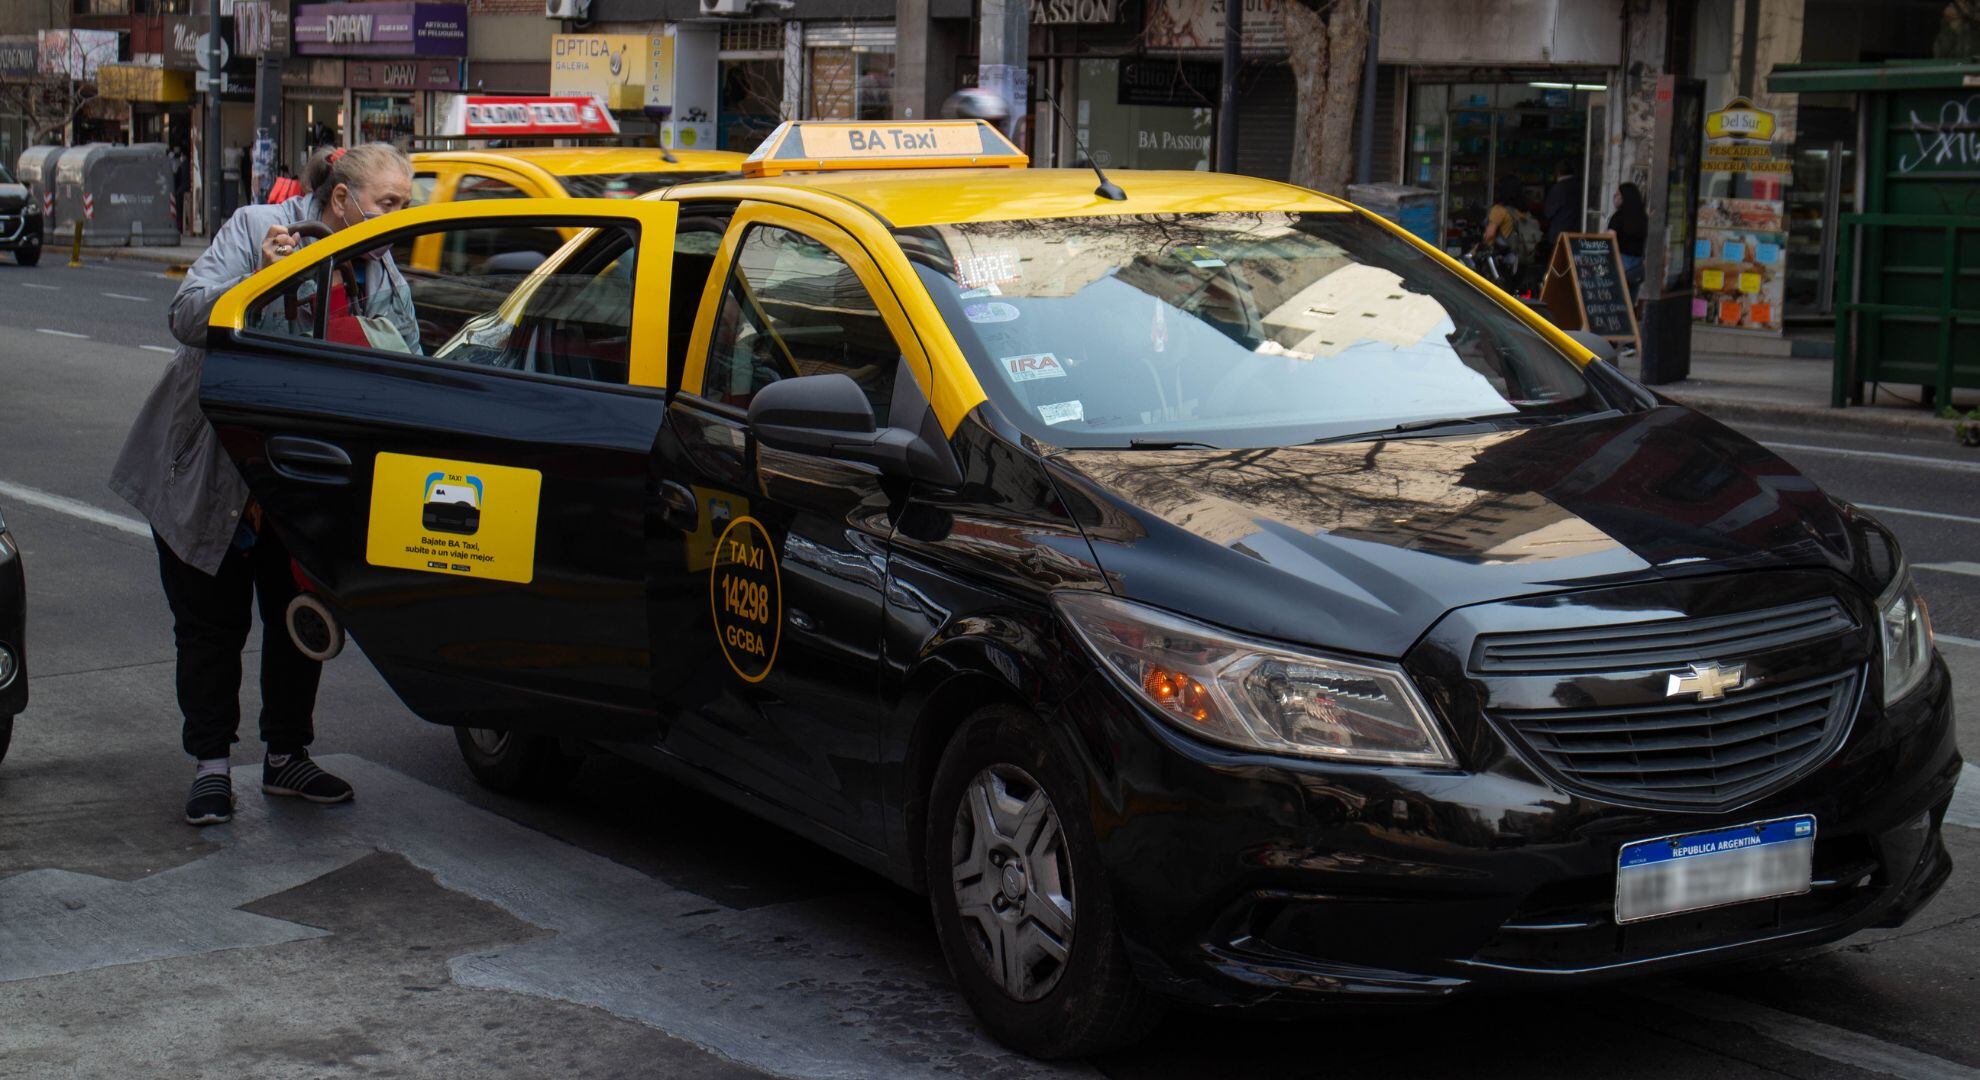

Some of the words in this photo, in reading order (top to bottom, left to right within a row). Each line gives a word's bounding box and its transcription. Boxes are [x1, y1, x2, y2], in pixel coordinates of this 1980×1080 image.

[556, 39, 610, 57] OPTICA
[555, 61, 590, 71] GALERIA
[652, 38, 662, 103] OPTICA
[467, 103, 529, 127] RADIO
[530, 103, 581, 125] TAXI
[1720, 114, 1739, 128] Del
[1741, 114, 1762, 129] Sur
[848, 129, 886, 150] BA
[887, 128, 937, 149] Taxi
[1138, 130, 1158, 148] BA
[1162, 131, 1211, 150] PASSION
[957, 254, 1014, 285] LIBRE
[1011, 356, 1058, 373] IRA
[448, 474, 462, 482] TAXI
[405, 545, 430, 555] subite
[438, 549, 448, 557] un
[450, 550, 469, 560] viaje
[470, 553, 495, 562] mejor.
[421, 536, 446, 547] Bajate
[448, 539, 460, 548] BA
[463, 541, 480, 551] Taxi,
[728, 540, 764, 571] TAXI
[722, 573, 769, 625] 14298
[726, 625, 766, 657] GCBA
[1672, 842, 1716, 857] REPUBLICA
[1717, 835, 1762, 850] ARGENTINA
